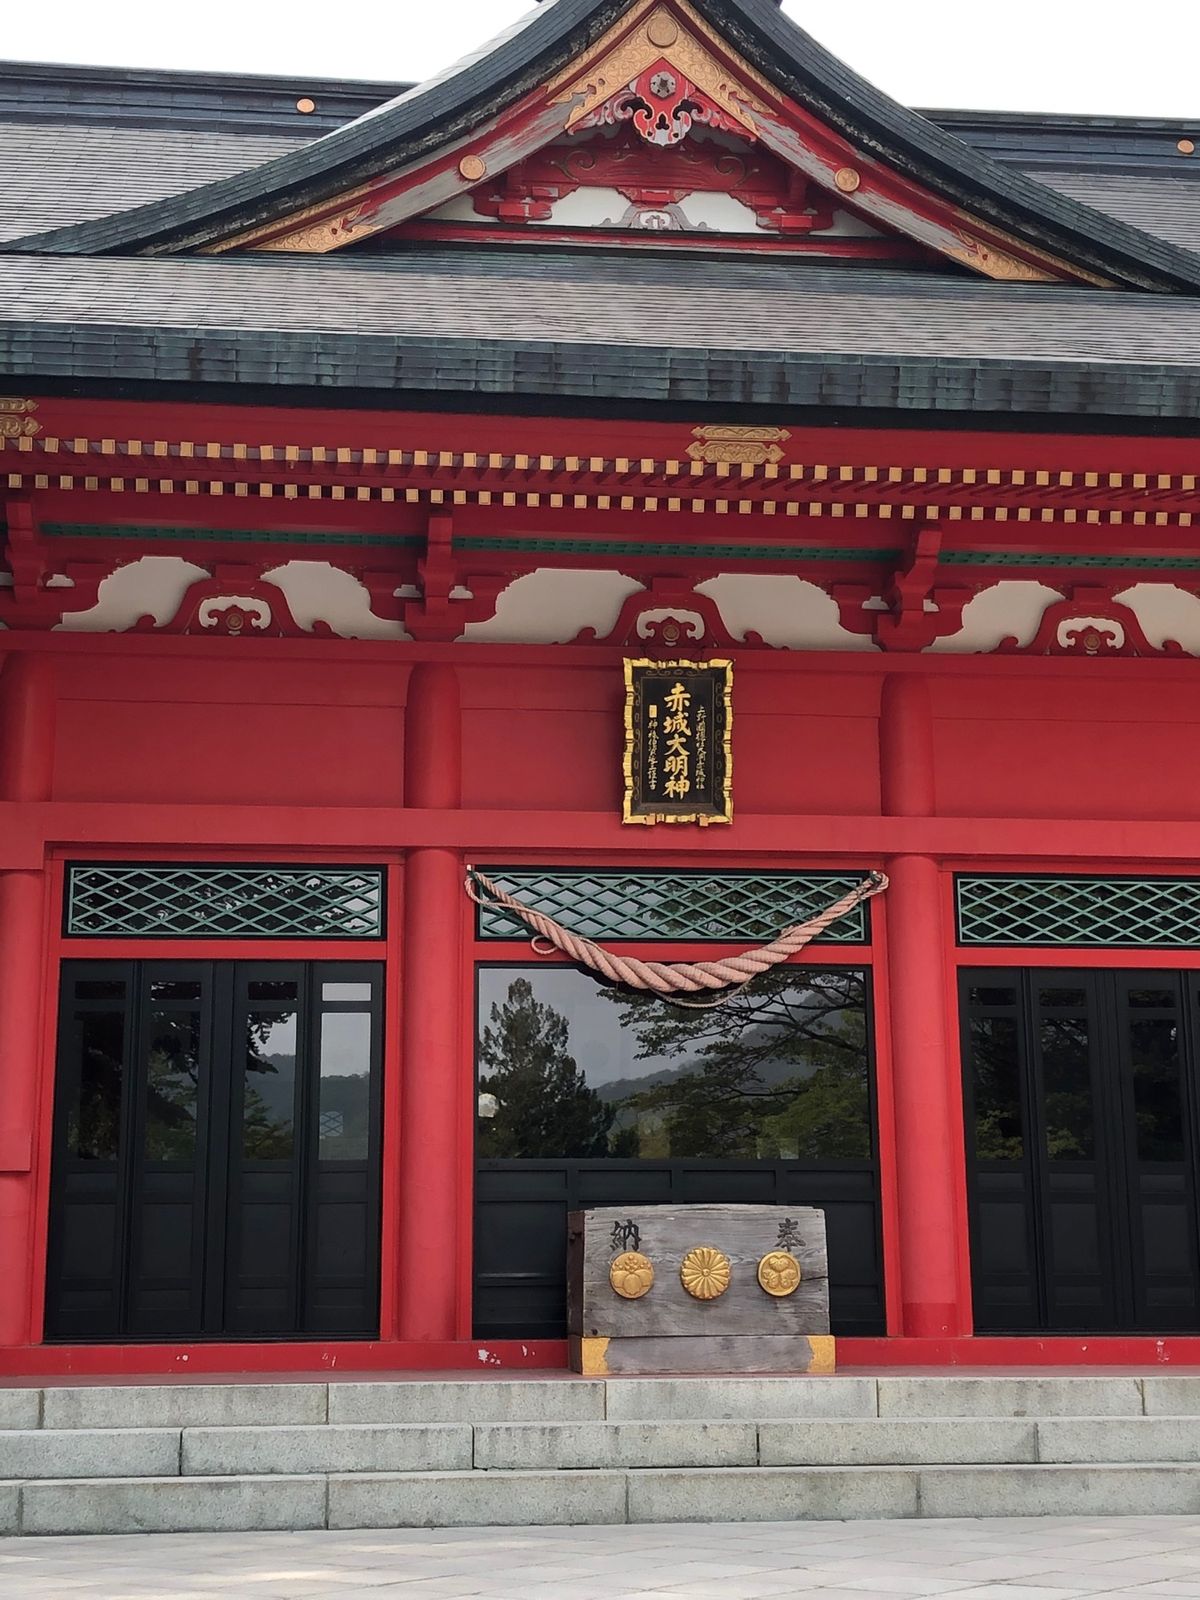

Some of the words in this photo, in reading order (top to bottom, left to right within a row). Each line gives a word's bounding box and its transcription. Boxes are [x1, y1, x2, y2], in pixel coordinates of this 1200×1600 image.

[662, 683, 692, 800] 赤城大明神
[609, 1218, 642, 1251] 納
[775, 1217, 806, 1252] 奉
